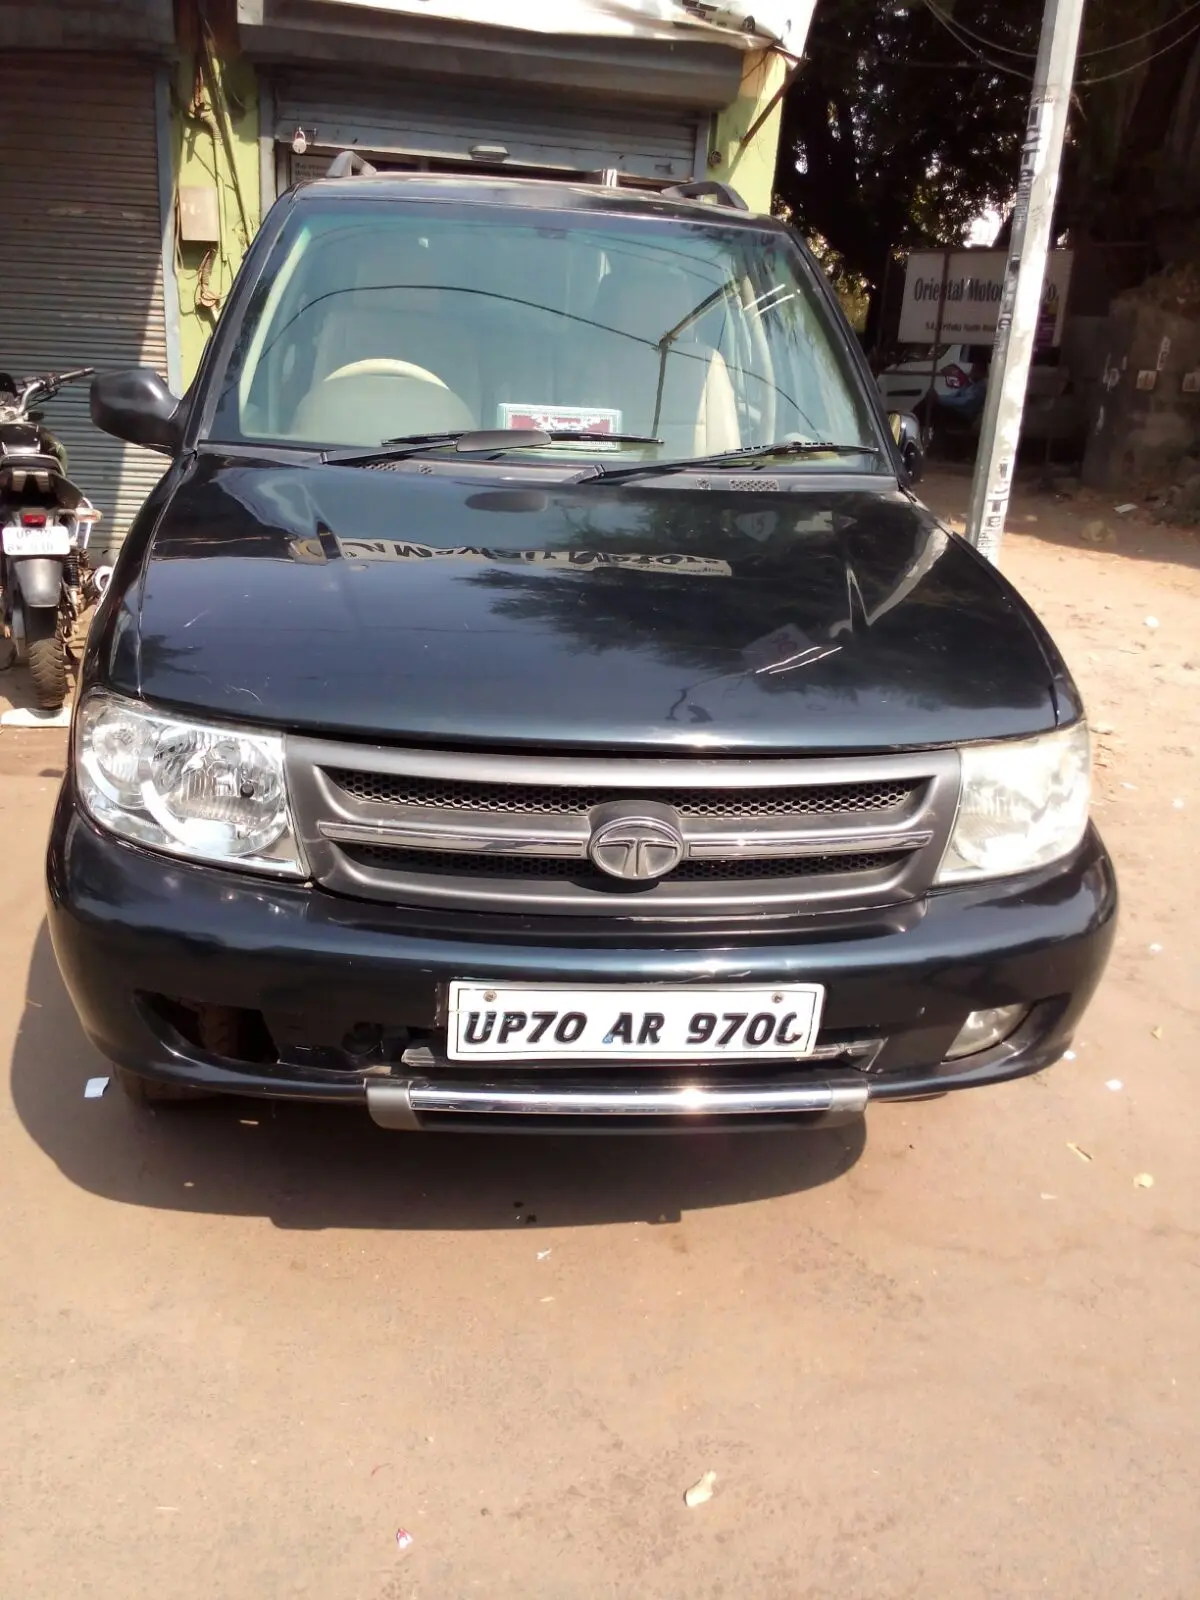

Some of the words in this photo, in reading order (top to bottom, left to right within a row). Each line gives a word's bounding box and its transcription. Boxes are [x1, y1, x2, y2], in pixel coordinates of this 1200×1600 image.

[914, 276, 965, 301] Orietal
[463, 1010, 588, 1045] UP70
[602, 1011, 665, 1045] AR
